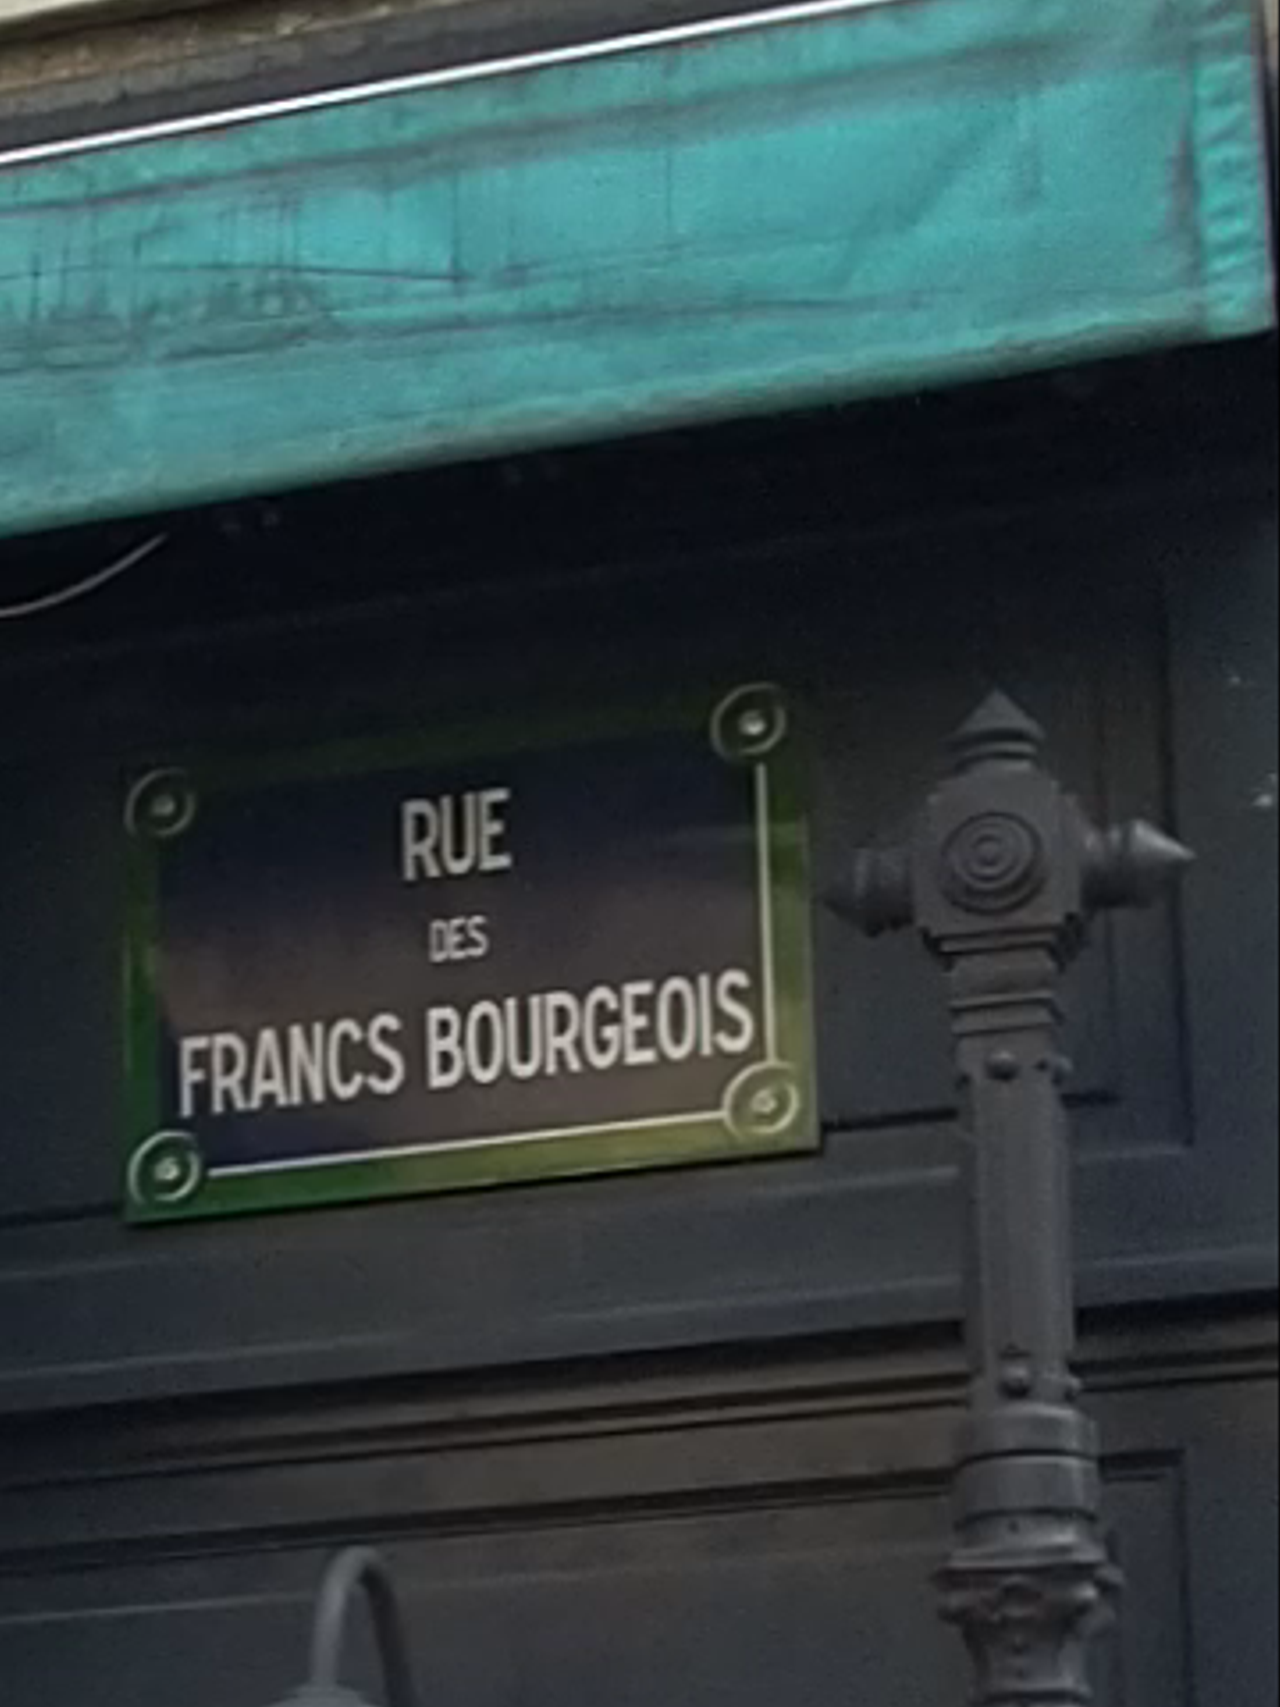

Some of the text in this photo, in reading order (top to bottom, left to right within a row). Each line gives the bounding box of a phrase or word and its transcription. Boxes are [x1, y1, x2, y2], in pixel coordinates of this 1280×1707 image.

[402, 788, 512, 881] RUE
[429, 915, 488, 963] DES
[178, 969, 755, 1119] FRANCS BOURGEOIS
